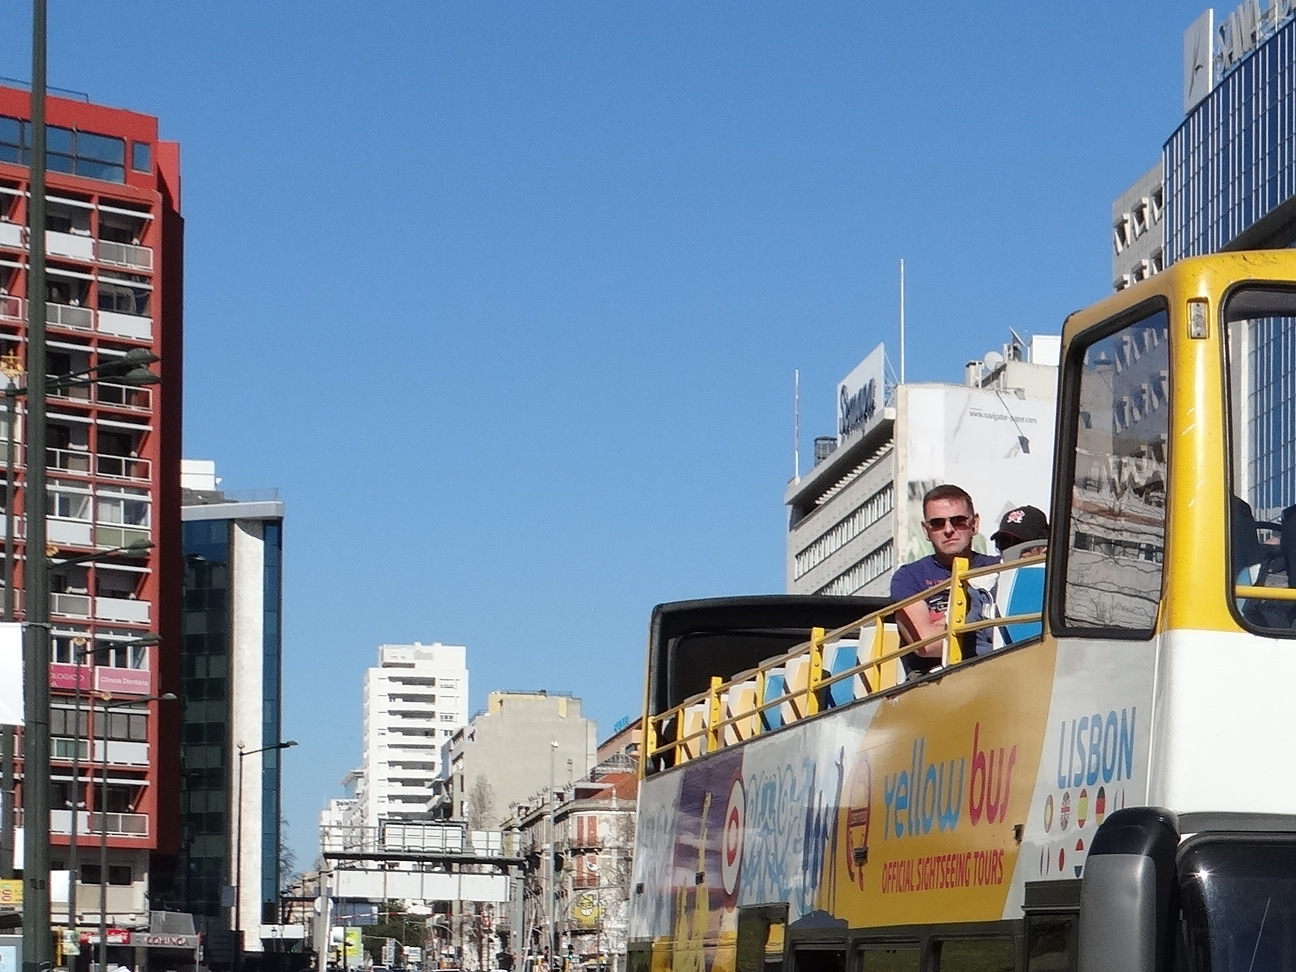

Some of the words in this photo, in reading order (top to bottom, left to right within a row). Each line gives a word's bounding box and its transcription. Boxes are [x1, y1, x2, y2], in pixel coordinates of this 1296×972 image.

[969, 721, 1018, 828] bus
[1057, 706, 1137, 790] LISBON
[882, 859, 915, 894] OFFICIAL
[915, 850, 971, 892] SIGHTSEEING
[972, 848, 1004, 886] TOURS
